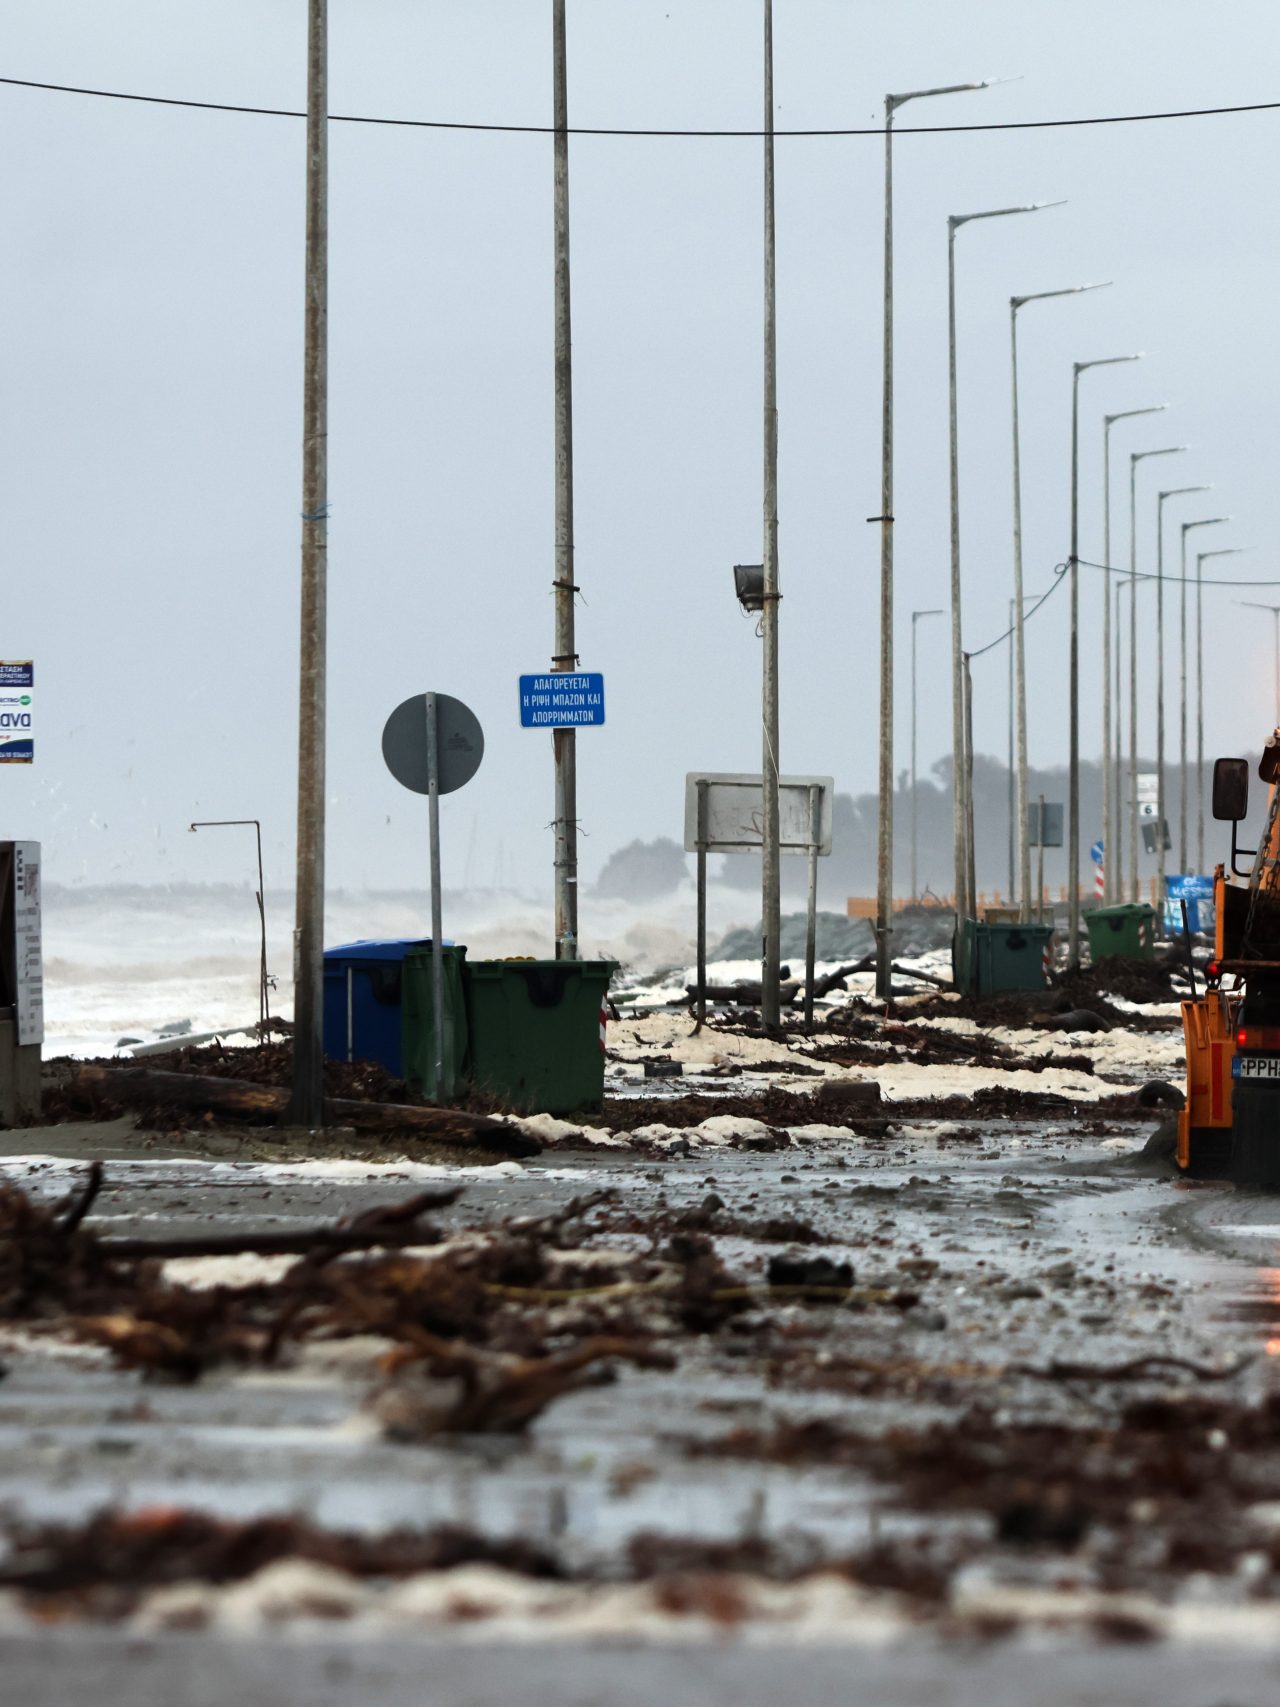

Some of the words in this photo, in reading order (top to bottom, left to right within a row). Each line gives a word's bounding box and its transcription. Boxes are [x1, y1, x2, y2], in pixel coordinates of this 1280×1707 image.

[534, 677, 590, 690] ΑΠΑΓΟΡΕΥΕΤΑΙ
[523, 695, 529, 707] Η
[532, 694, 550, 706] ΡΙΨΗ
[553, 693, 585, 706] ΜΠΑΖΩΝ
[588, 693, 601, 705] ΚΑΙ
[532, 710, 594, 723] ΑΠΟΡΡΙΜΜΑΤΩΝ
